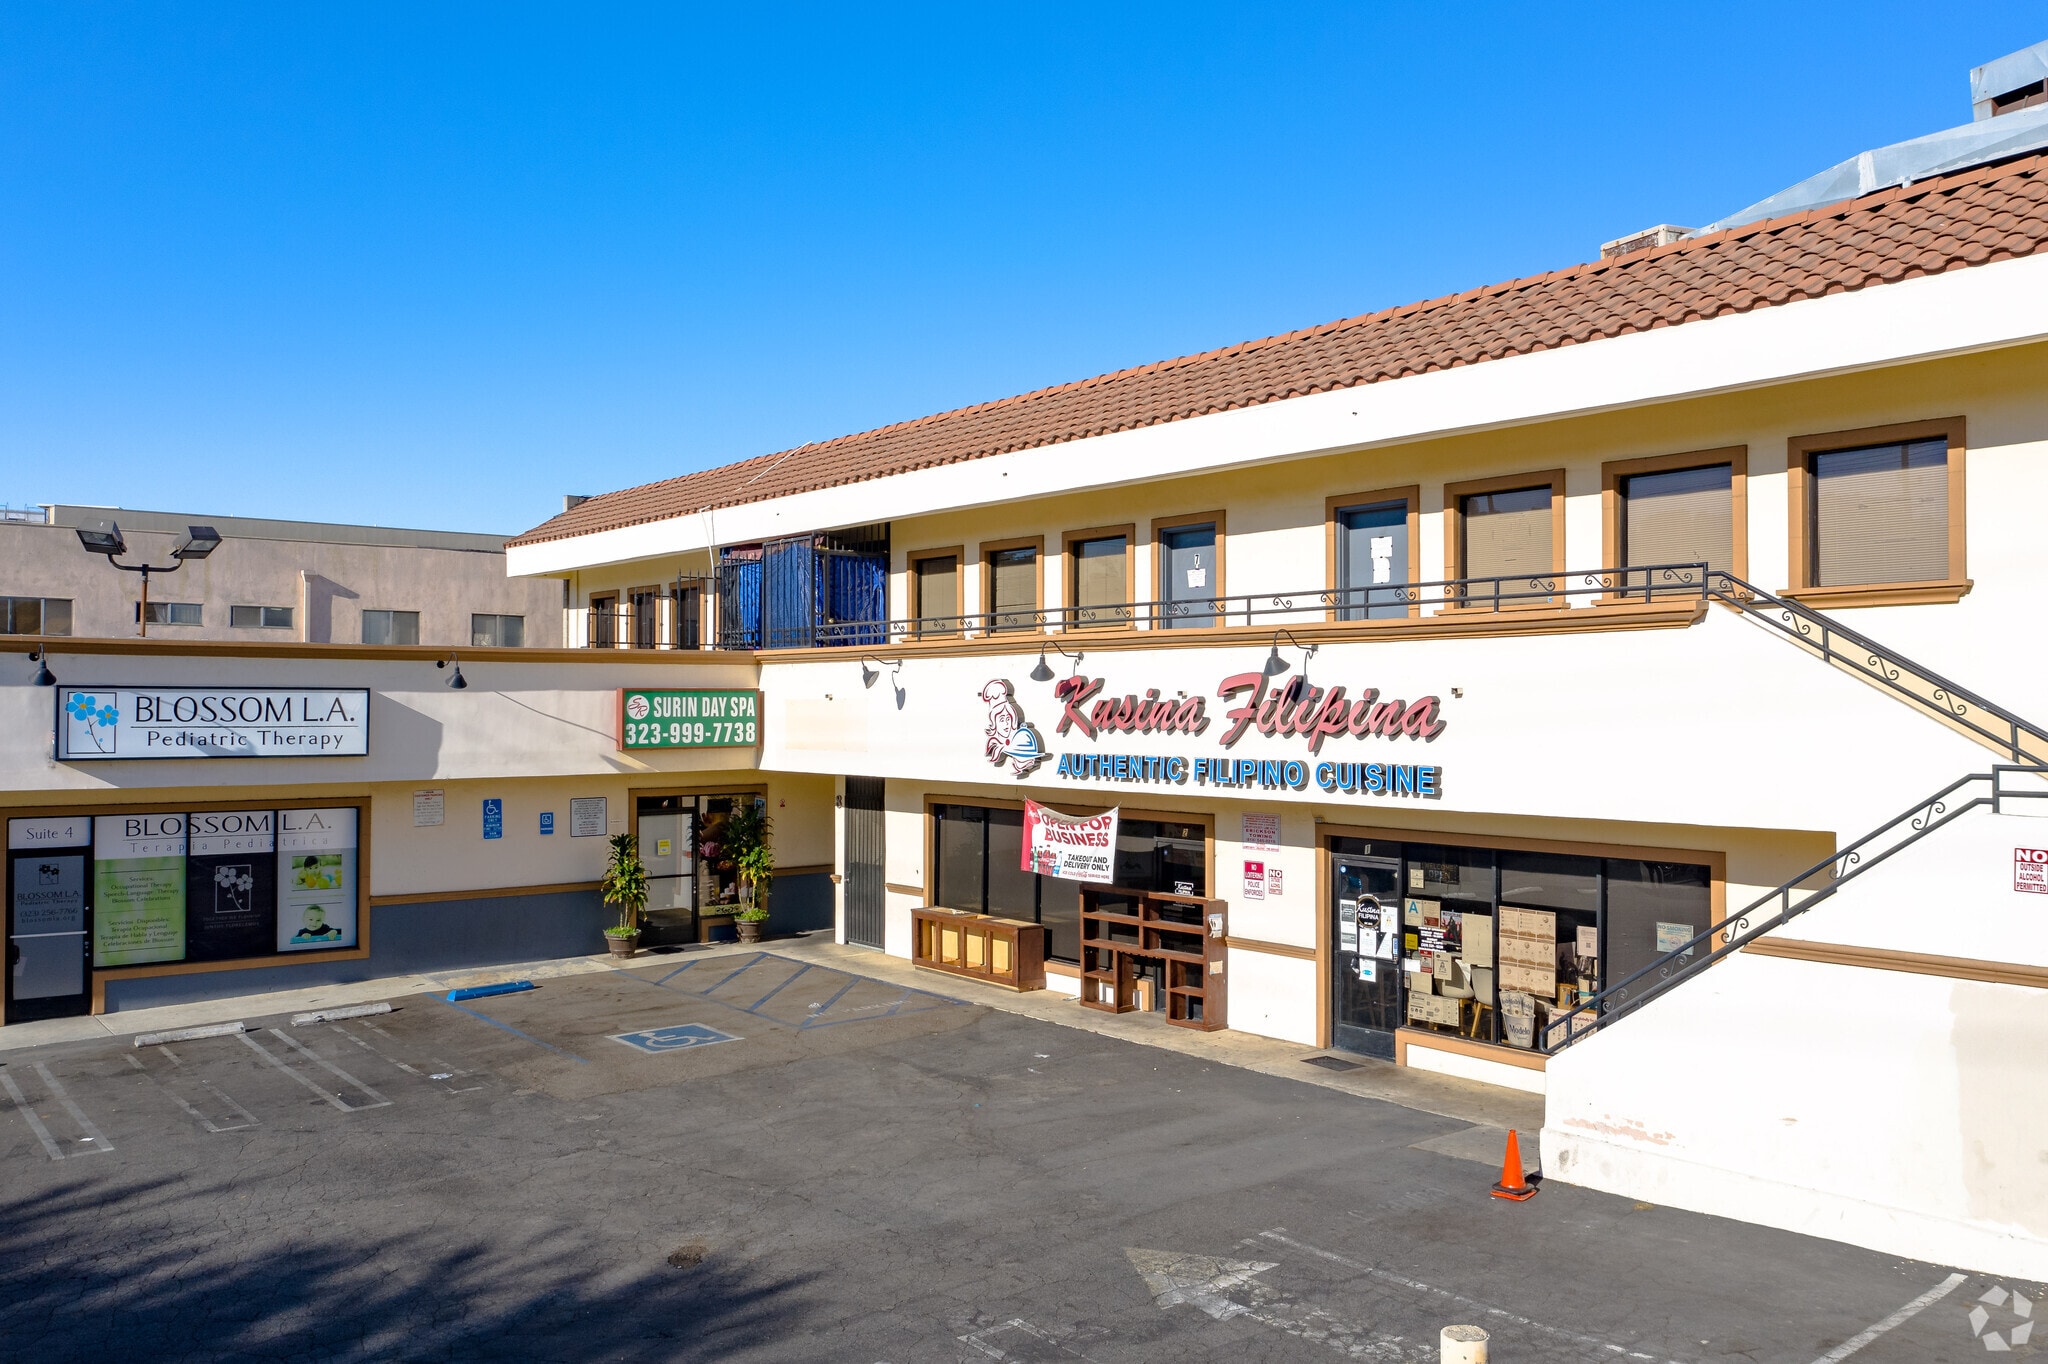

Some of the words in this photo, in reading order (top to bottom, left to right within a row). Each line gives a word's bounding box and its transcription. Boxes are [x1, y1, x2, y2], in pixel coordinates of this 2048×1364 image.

[135, 696, 292, 723] BLOSSOM
[302, 696, 355, 722] L.A.
[653, 696, 698, 718] SURIN
[702, 696, 728, 718] DAY
[730, 696, 756, 717] SPA
[1054, 675, 1205, 738] Kusina
[1216, 672, 1442, 753] Filipina
[625, 722, 756, 744] 323-999-7738
[147, 730, 248, 747] Pediatric
[256, 730, 344, 750] Therapy
[1057, 753, 1184, 782] AUTHENTIC
[1193, 757, 1305, 788] FILIPINO
[1315, 762, 1436, 795] CUISINE
[124, 814, 270, 838] BLOSSOM
[282, 812, 333, 831] L.A.
[1041, 813, 1077, 832] OPEN
[1080, 815, 1113, 831] FOR
[26, 827, 59, 841] Suite
[64, 826, 74, 839] 4
[1044, 827, 1109, 848] BUSINESS
[131, 840, 209, 855] Terapia
[223, 836, 329, 850] Pediatrica
[1067, 853, 1093, 863] TAKEOUT
[1093, 856, 1108, 864] AND
[2015, 849, 2048, 863] NO
[1063, 860, 1091, 870] DELIVERY
[1091, 863, 1110, 872] ONLY
[2019, 863, 2044, 873] OUTSIDE
[1245, 871, 1264, 880] LOITERING
[2018, 872, 2045, 883] ALCOHOL
[111, 883, 149, 891] Occupational
[151, 881, 173, 889] Therapy
[1248, 881, 1260, 889] POLICE
[2016, 881, 2047, 892] PERMITTED
[17, 891, 63, 900] BLOSSOM
[65, 890, 82, 898] L.A.
[157, 888, 179, 897] Therapy
[1244, 889, 1263, 897] ENFORCED
[1356, 904, 1380, 914] Kusina
[1408, 901, 1418, 913] A
[1357, 912, 1379, 921] FILIPINA
[154, 930, 178, 938] Lenguaje
[1667, 925, 1691, 933] SMOKING
[1508, 1024, 1531, 1036] Modelo
